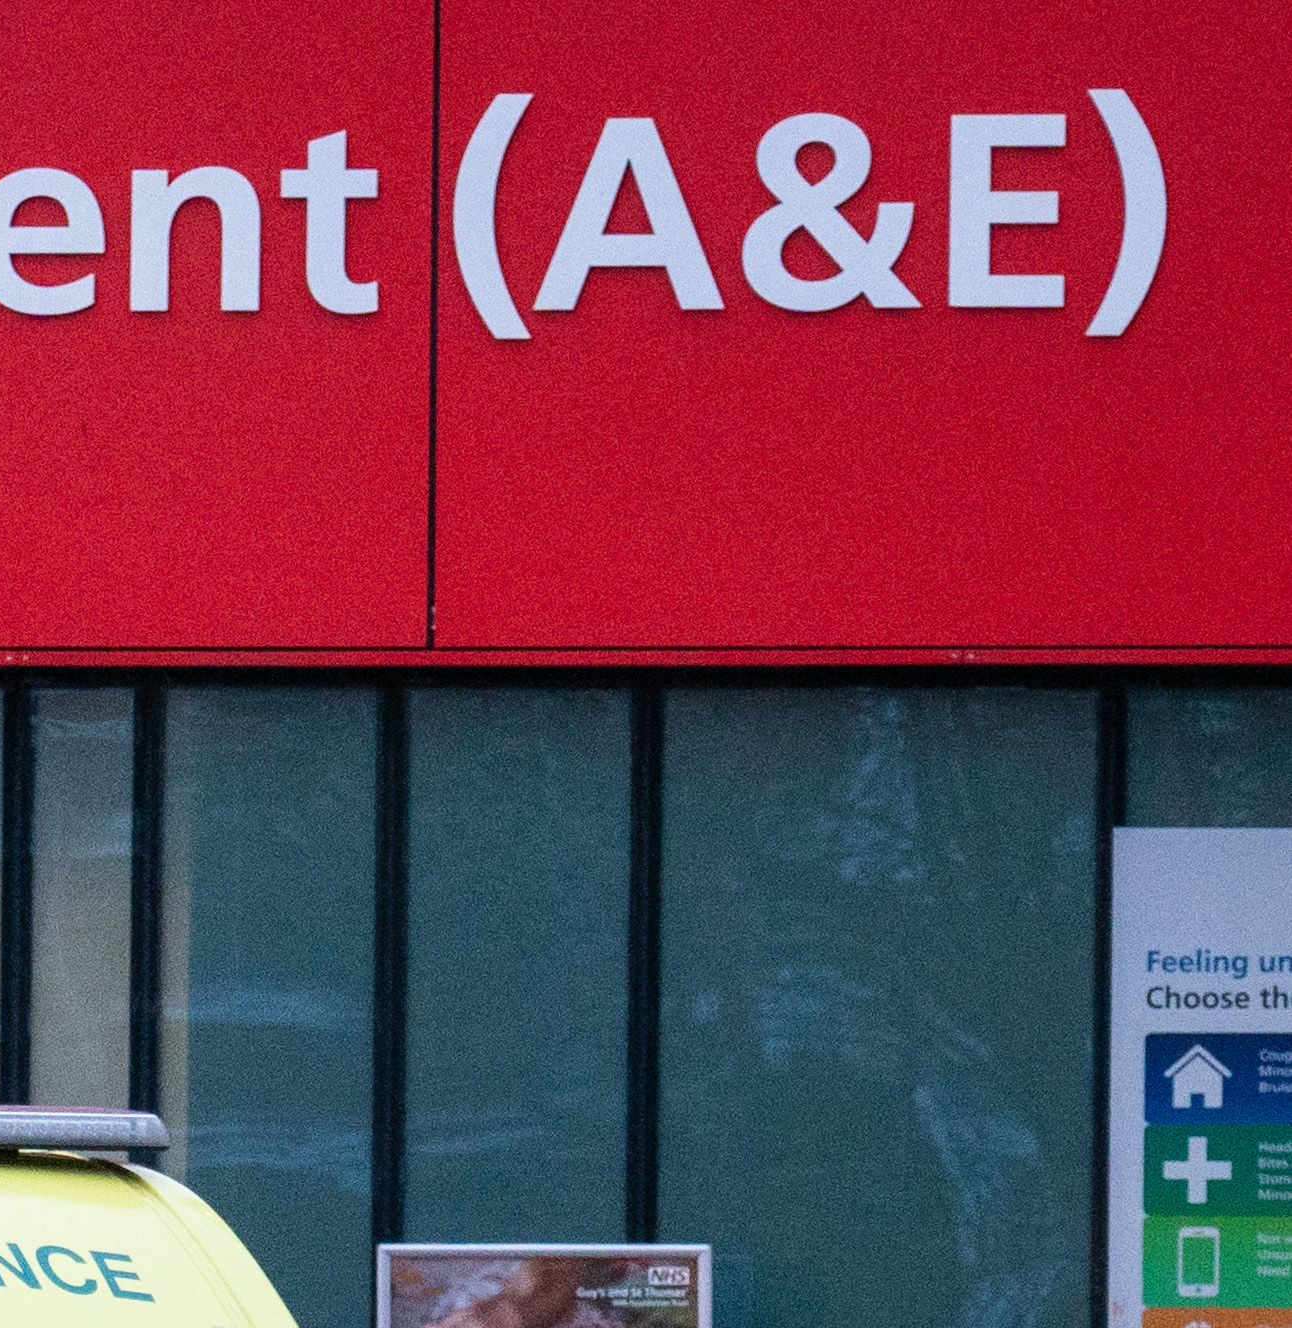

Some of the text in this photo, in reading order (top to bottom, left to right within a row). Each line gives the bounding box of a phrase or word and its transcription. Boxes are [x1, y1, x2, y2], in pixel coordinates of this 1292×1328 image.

[452, 88, 1167, 340] (A&E)
[1146, 949, 1249, 980] Feeling
[1146, 985, 1292, 1009] Choose th
[651, 1268, 689, 1283] NHS
